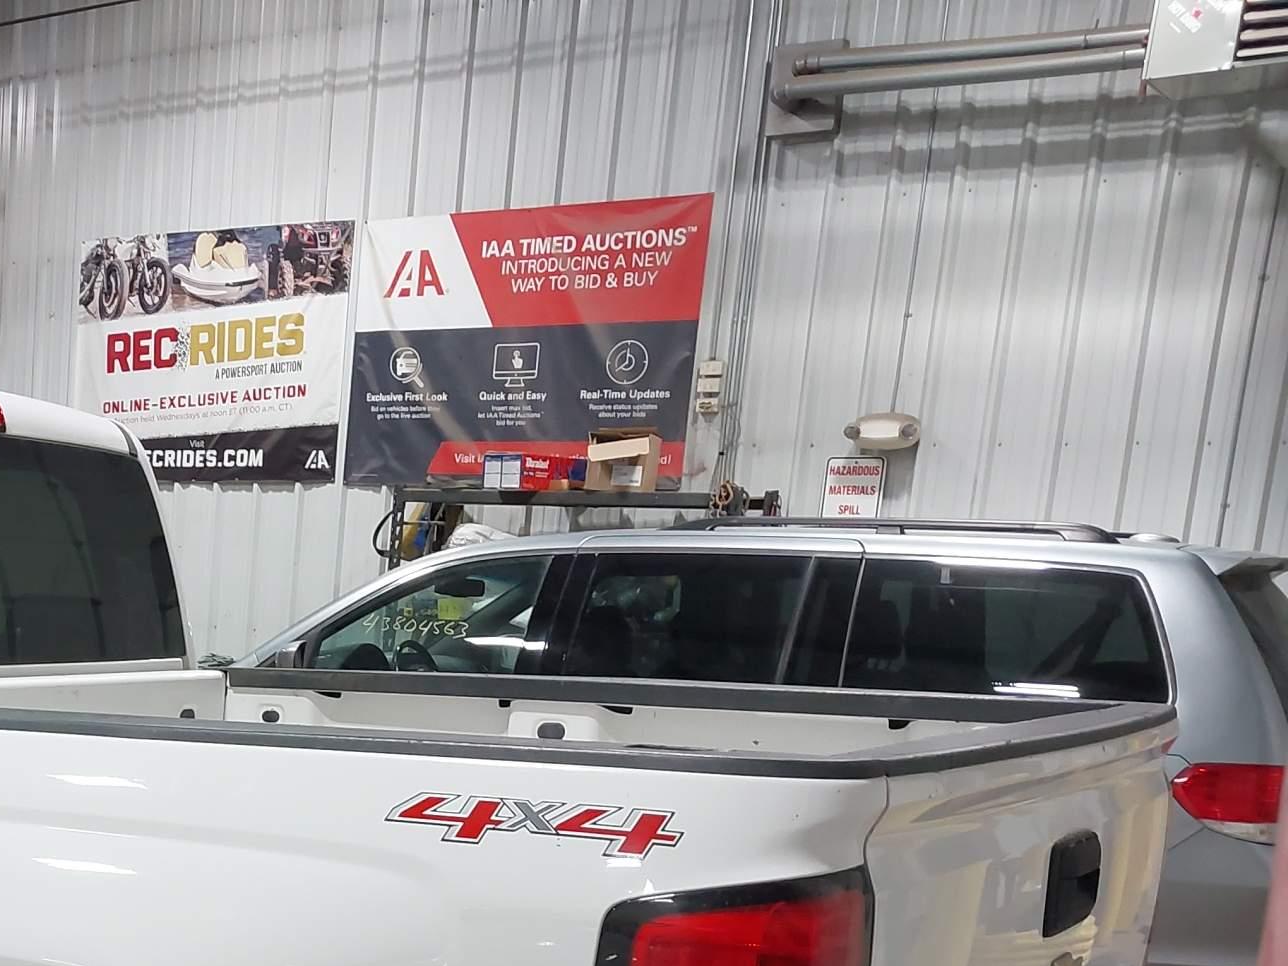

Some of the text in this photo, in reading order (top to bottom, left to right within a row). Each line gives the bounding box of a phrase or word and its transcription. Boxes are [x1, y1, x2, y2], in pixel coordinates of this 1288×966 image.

[481, 239, 515, 259] IAA
[519, 235, 577, 257] TIMED
[501, 250, 673, 276] INTRODUCING A NEW
[510, 270, 659, 294] WAY TO BID & BUY
[106, 312, 305, 373] REC RIDES
[221, 363, 268, 380] POWERSPORT
[269, 360, 302, 374] AUCTION
[103, 384, 307, 415] ONLINE-EXCLUSIVE AUCTION
[366, 391, 448, 402] Exclusive First Look
[479, 391, 547, 403] Quick and Easy
[580, 389, 671, 401] Real-Time Updates
[190, 439, 204, 448] Visit
[144, 448, 263, 468] ECRIDES.COM
[454, 453, 475, 464] Visit
[829, 465, 880, 476] HAZARDOUS
[828, 485, 876, 496] MATERIALS
[838, 505, 860, 515] SPILL
[363, 612, 469, 639] 43804563
